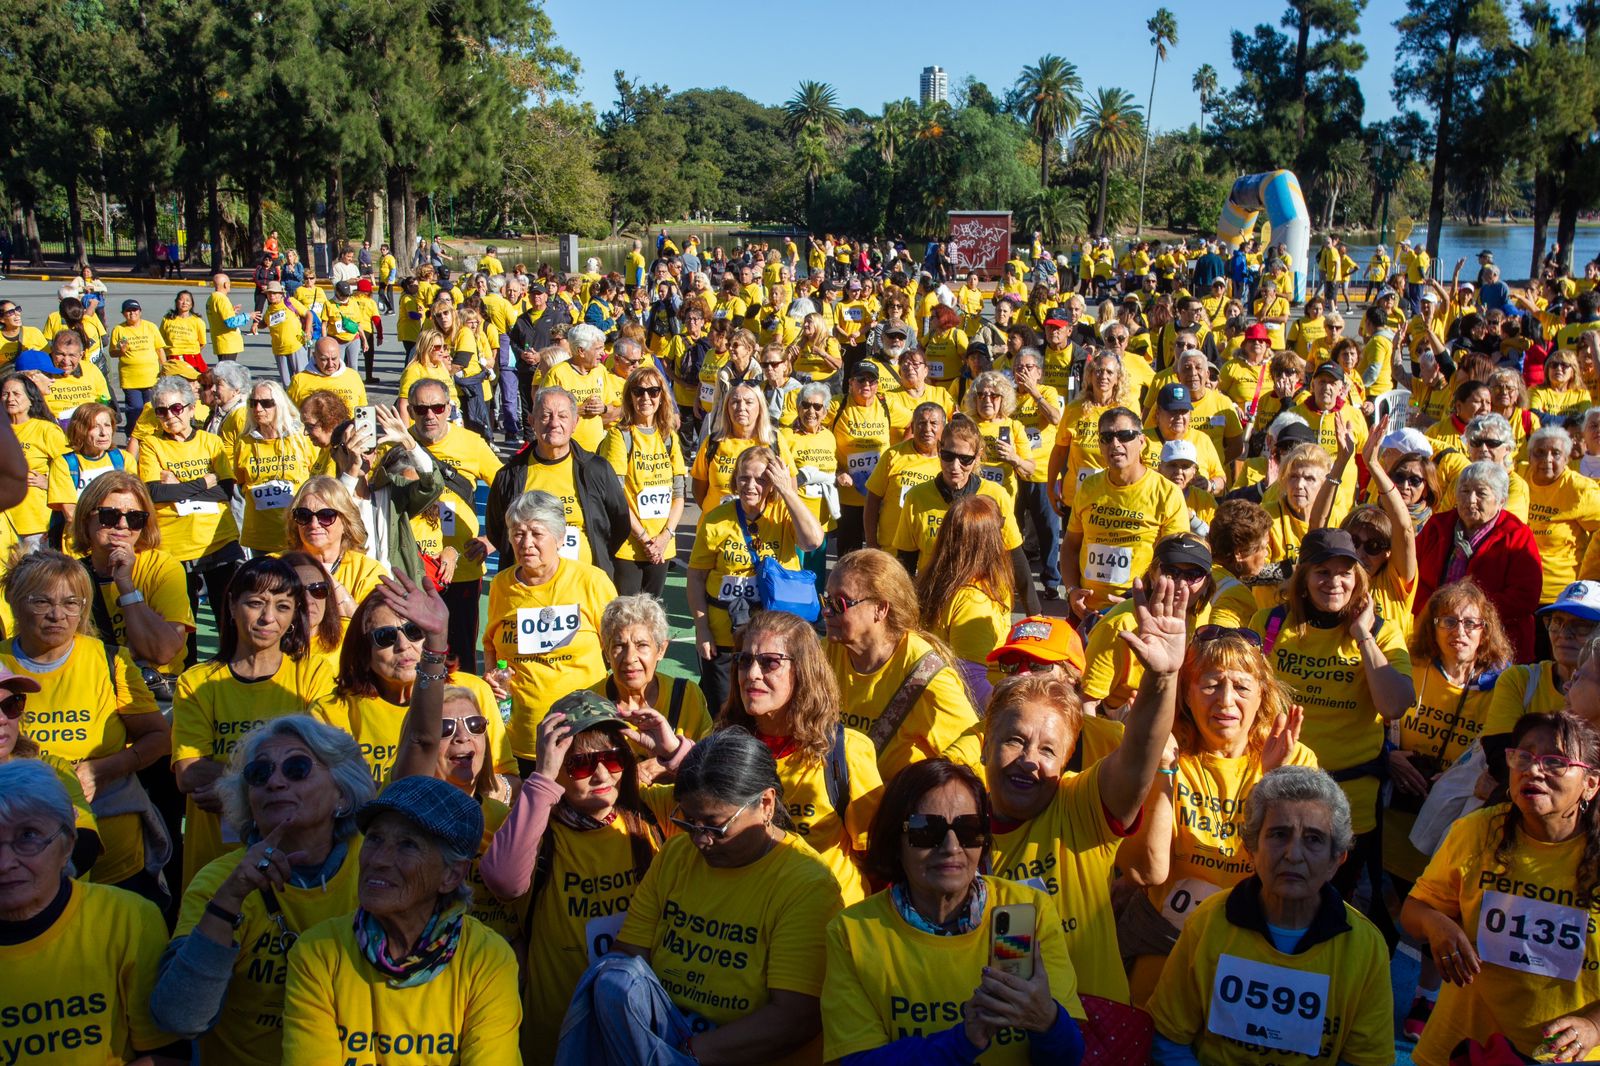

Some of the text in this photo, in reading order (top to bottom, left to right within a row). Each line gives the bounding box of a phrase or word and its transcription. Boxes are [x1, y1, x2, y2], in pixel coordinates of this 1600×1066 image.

[50, 385, 93, 393] Personas
[53, 392, 92, 401] Mayores
[848, 420, 885, 430] Personas
[848, 428, 885, 438] Mayores
[249, 454, 297, 465] Personas
[634, 451, 670, 462] Persona
[849, 455, 879, 468] 0671
[636, 461, 671, 471] Mayore
[254, 485, 292, 499] 0194
[1091, 503, 1145, 520] Personas
[1088, 514, 1142, 530] Mayores
[1088, 551, 1130, 569] 0140
[722, 582, 759, 598] 088
[521, 614, 579, 635] 0019
[1276, 648, 1360, 668] Personas
[1277, 656, 1356, 684] Mayores
[1306, 683, 1322, 695] en
[25, 708, 91, 724] sonas
[1190, 853, 1255, 874] movimie
[662, 899, 759, 945] Personas
[1485, 907, 1581, 951] 0135
[662, 924, 749, 970] Mayores
[686, 969, 705, 985] en
[660, 976, 750, 1011] movimiento
[1219, 974, 1321, 1020] 0599
[0, 992, 108, 1028] sonas
[1245, 1022, 1269, 1039] BA
[336, 1024, 462, 1057] Persona
